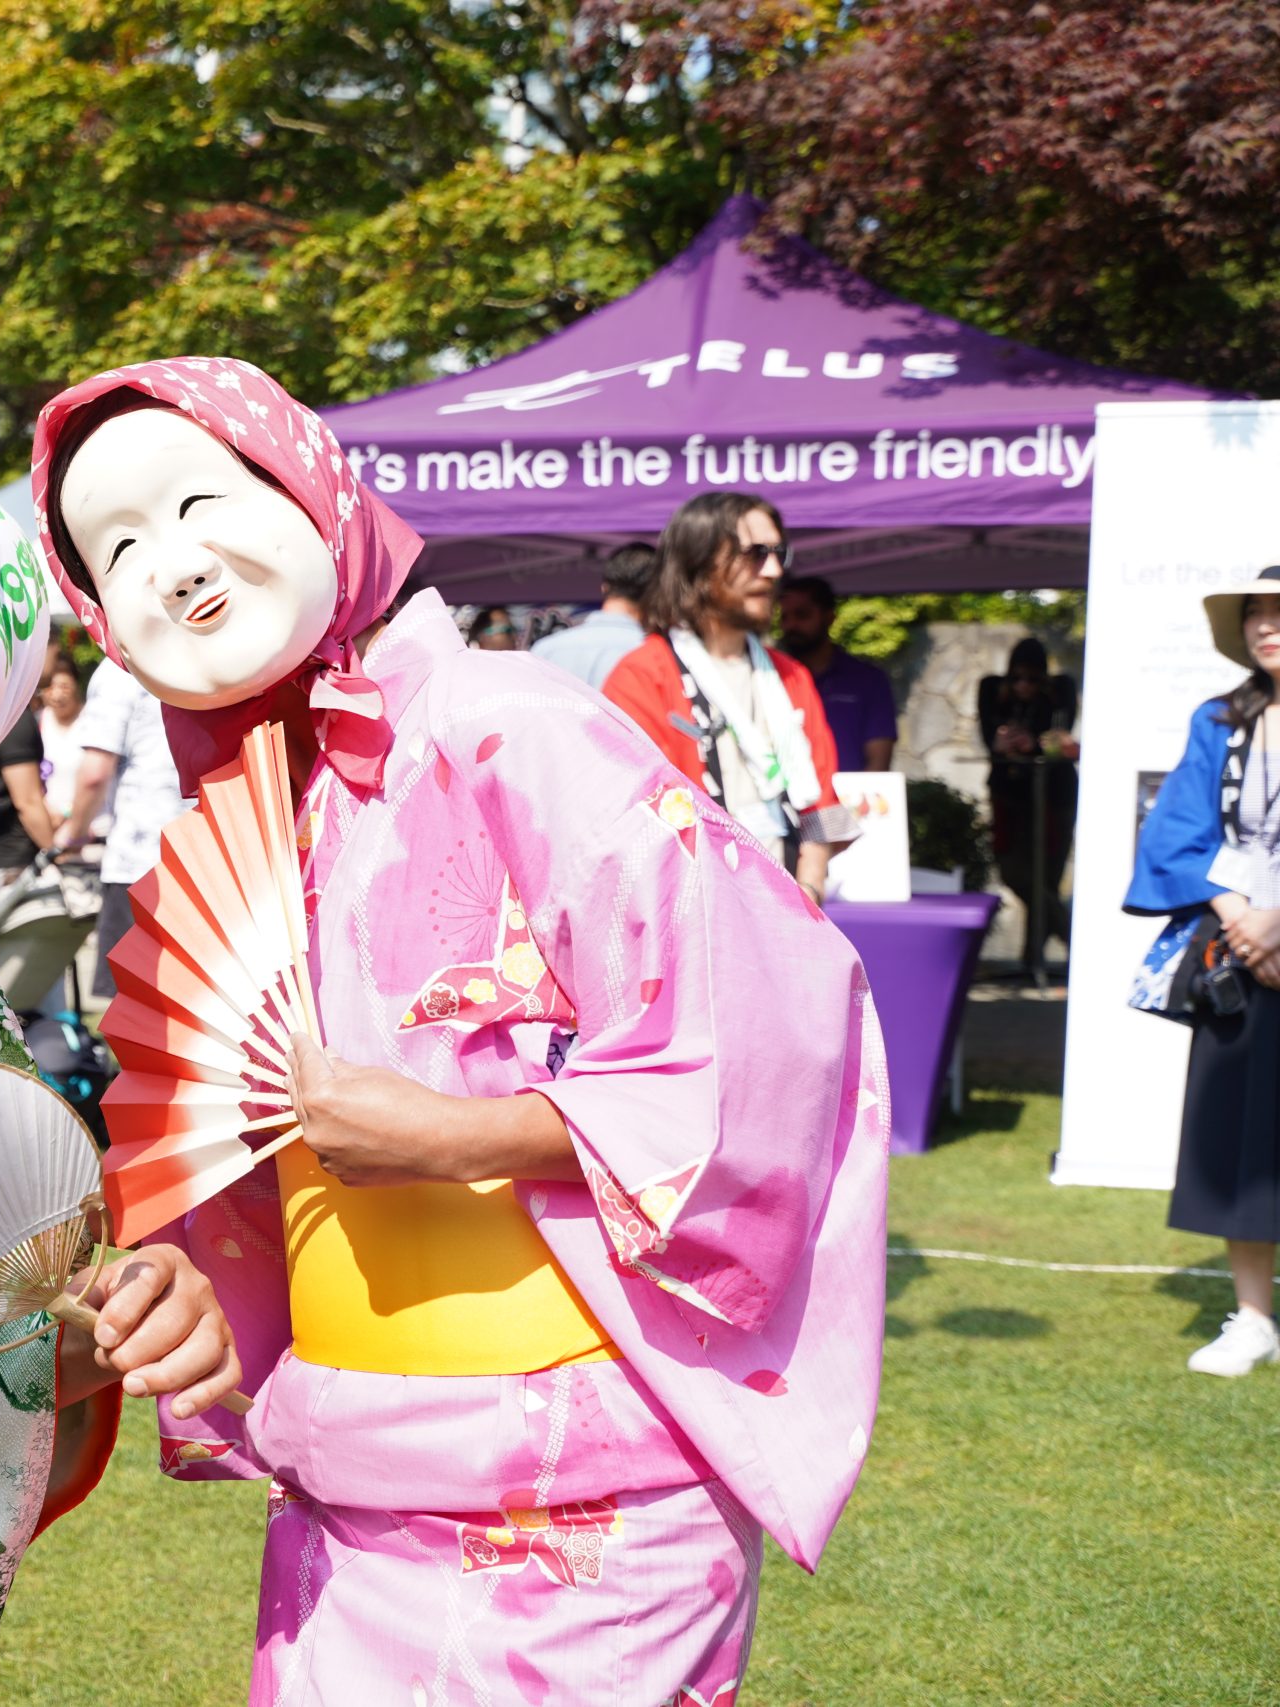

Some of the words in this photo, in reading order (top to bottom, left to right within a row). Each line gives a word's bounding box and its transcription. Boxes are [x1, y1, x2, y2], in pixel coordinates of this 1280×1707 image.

[637, 339, 959, 388] TELUS
[346, 442, 408, 493] t's
[416, 438, 569, 492] make
[577, 435, 672, 487] the
[680, 433, 859, 485] future
[869, 424, 1096, 489] friendly
[1121, 561, 1166, 587] Let
[1176, 560, 1222, 587] the
[1229, 560, 1261, 587] sh
